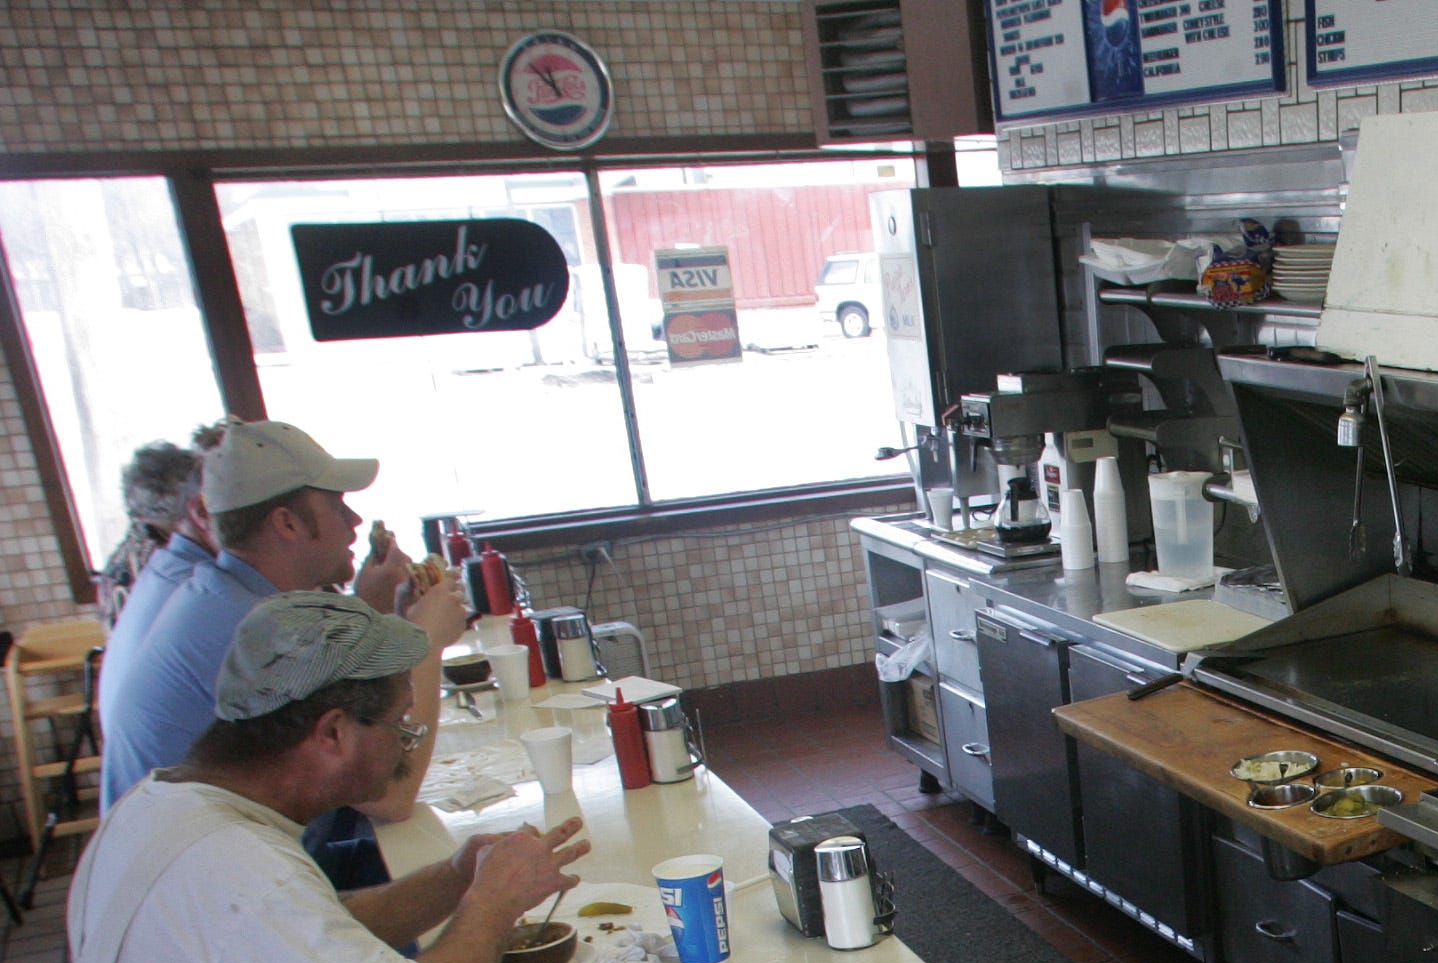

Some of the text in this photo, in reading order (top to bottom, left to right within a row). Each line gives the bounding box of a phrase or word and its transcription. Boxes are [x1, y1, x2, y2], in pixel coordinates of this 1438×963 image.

[321, 225, 487, 316] Thank
[452, 279, 555, 329] You
[712, 896, 729, 954] PEPSI
